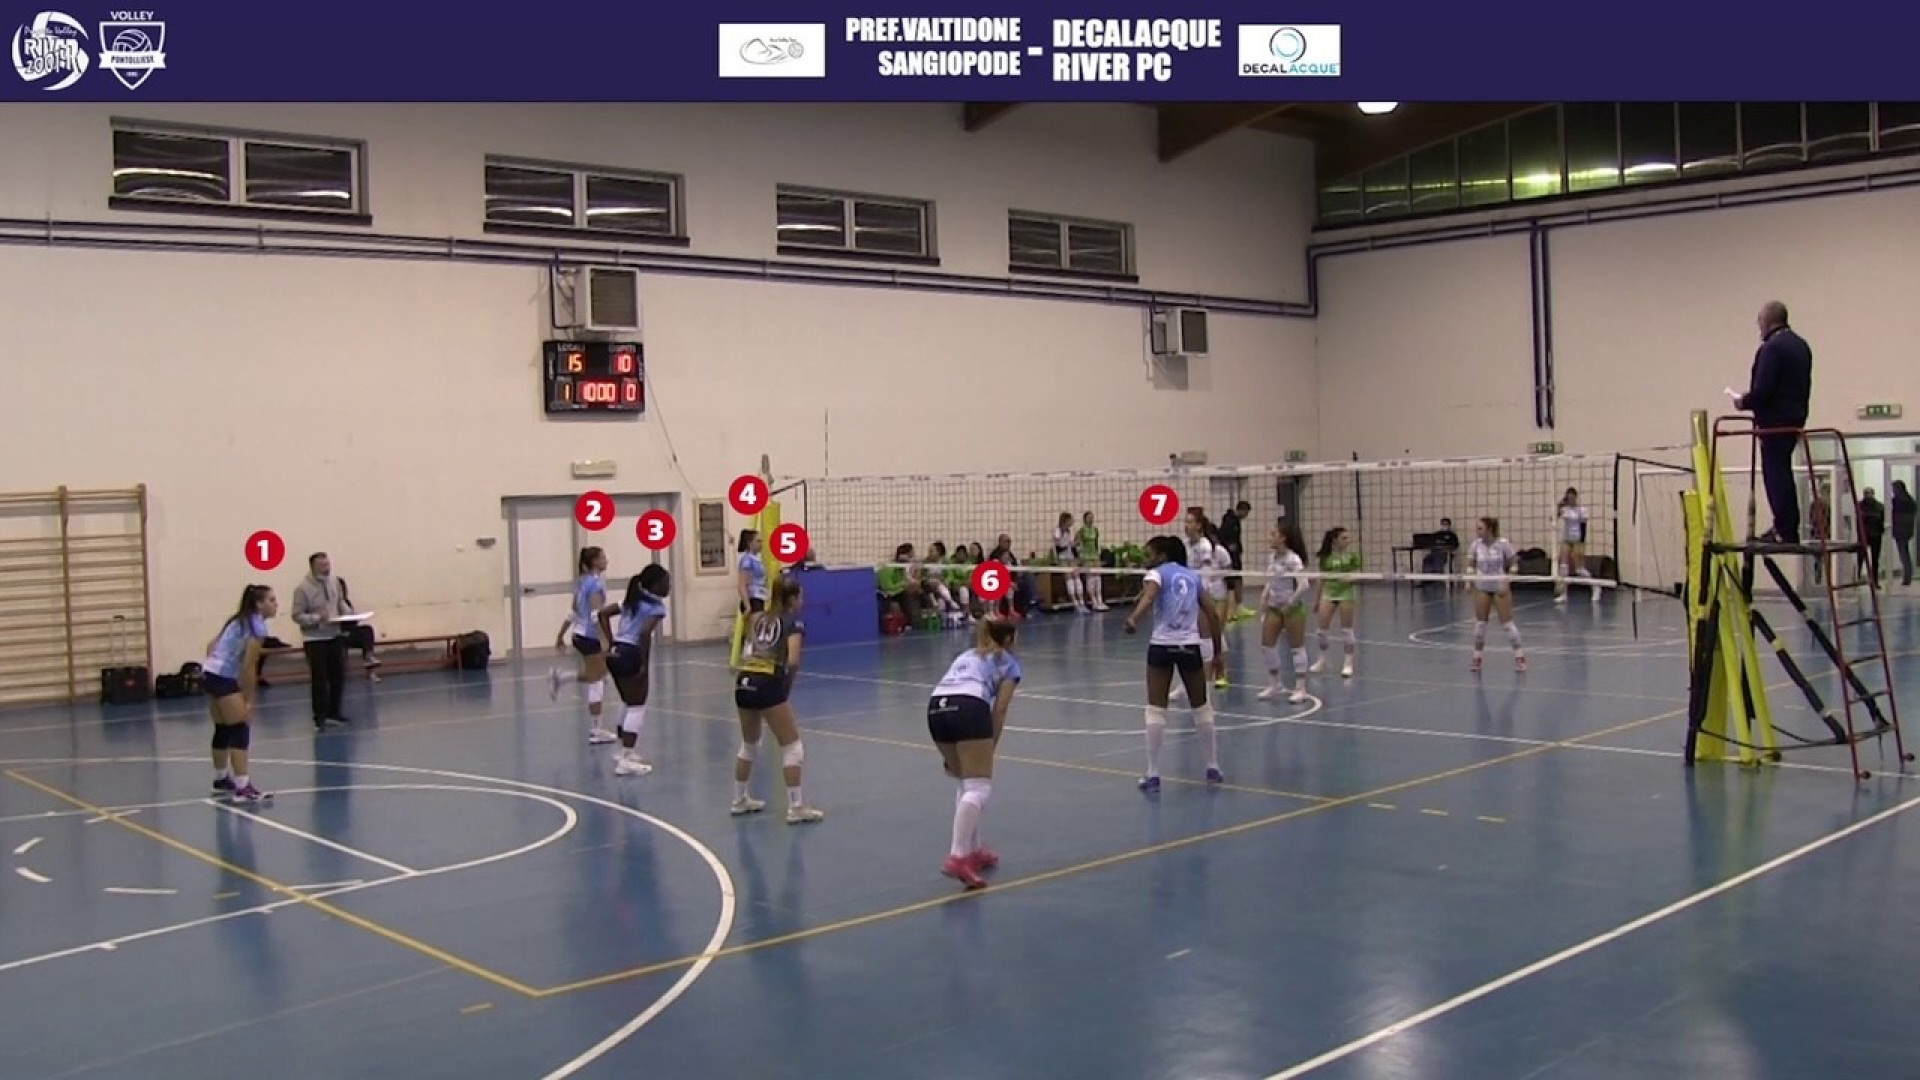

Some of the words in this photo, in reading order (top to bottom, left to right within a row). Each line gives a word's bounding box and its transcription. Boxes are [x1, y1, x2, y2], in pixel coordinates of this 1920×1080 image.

[568, 353, 583, 372] 15
[617, 354, 632, 373] 10
[564, 384, 570, 400] 1
[626, 383, 637, 401] 0
